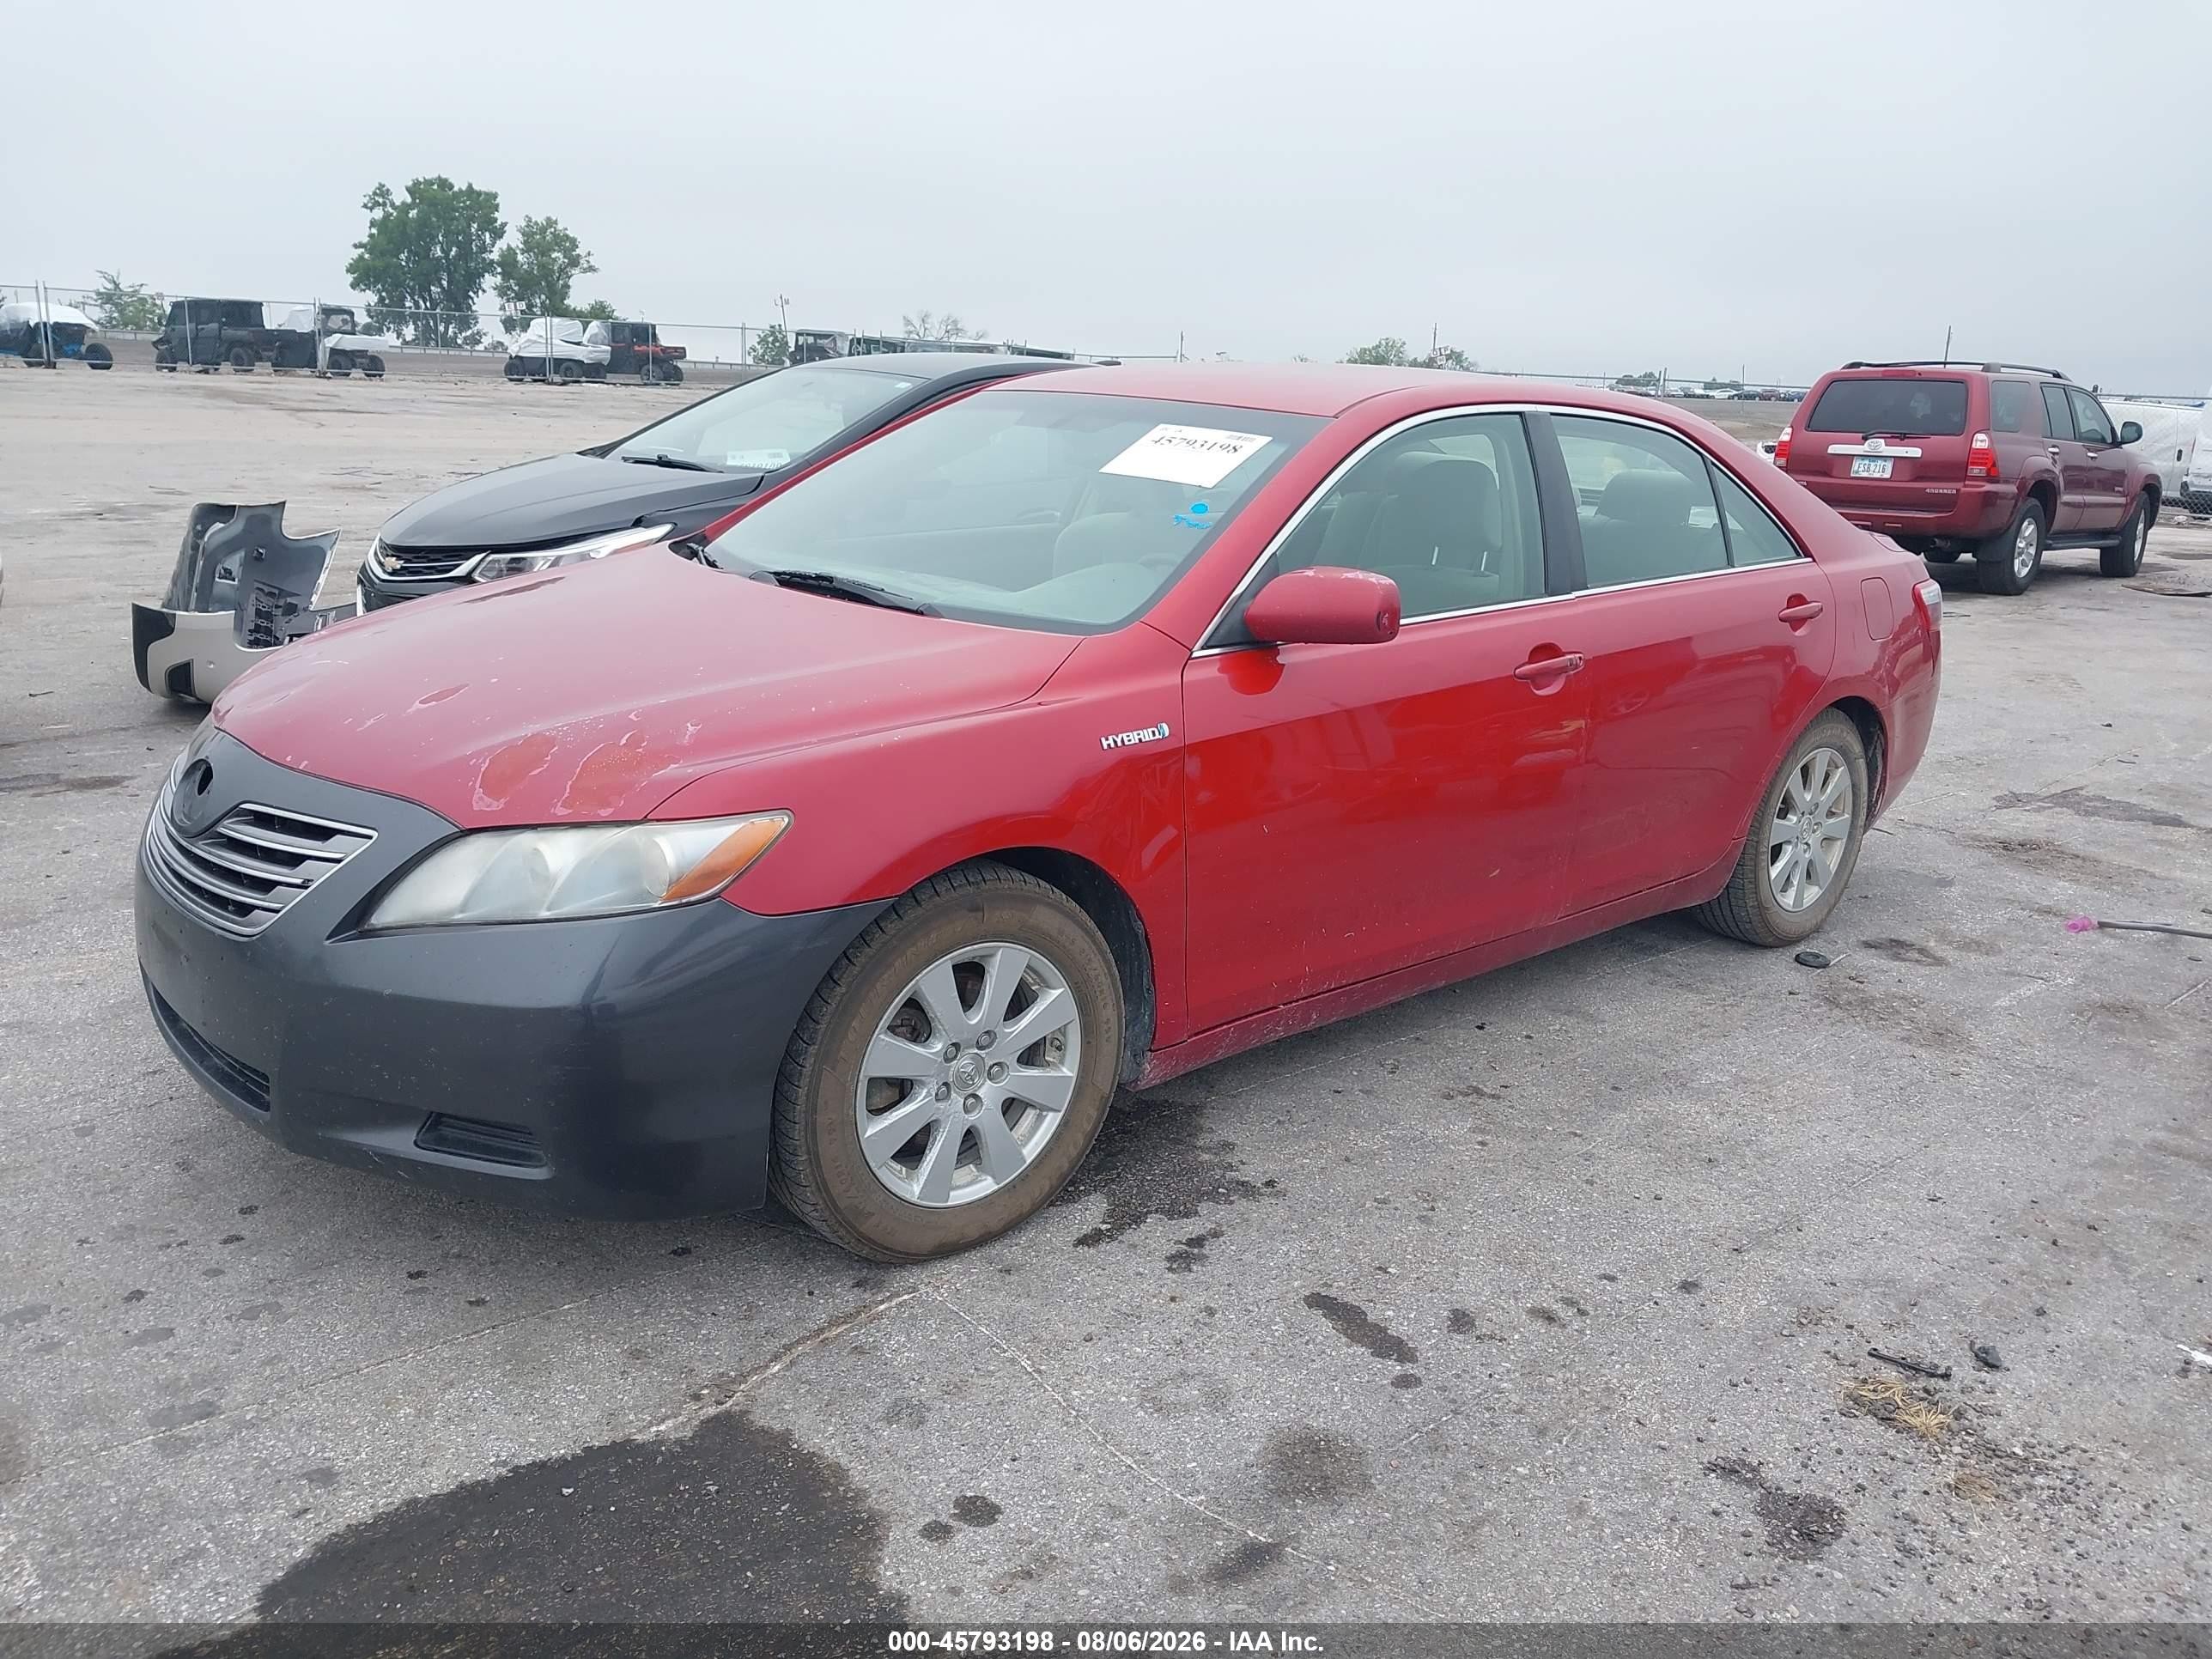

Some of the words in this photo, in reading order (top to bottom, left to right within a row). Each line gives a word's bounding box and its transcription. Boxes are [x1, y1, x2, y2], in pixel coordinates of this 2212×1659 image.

[1152, 435, 1243, 454] 45793198
[1873, 464, 1887, 474] 216
[1100, 727, 1161, 750] HYBRID
